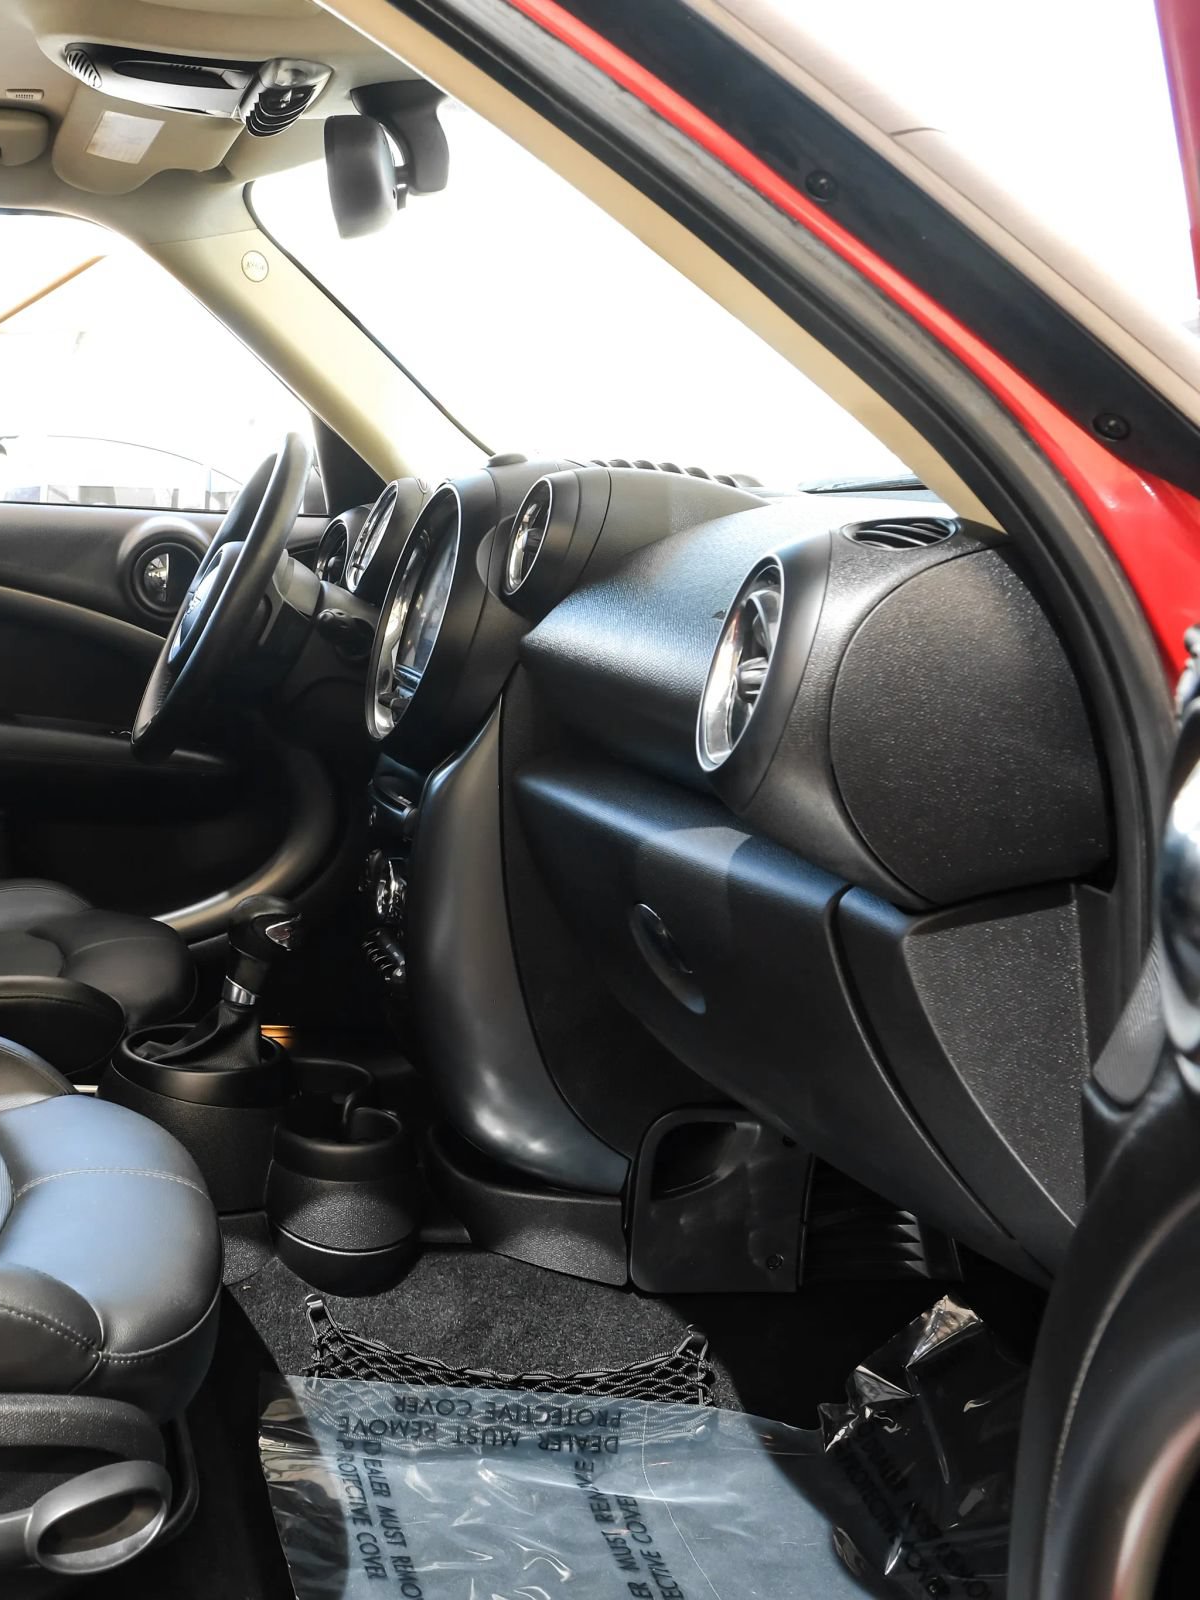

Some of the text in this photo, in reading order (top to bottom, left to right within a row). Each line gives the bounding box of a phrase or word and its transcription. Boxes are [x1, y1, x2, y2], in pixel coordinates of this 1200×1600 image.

[339, 1415, 619, 1455] DEALER MUST REMOVE
[394, 1395, 622, 1429] PROTECTIVE COVER
[335, 1438, 388, 1580] PROTECTIVE COVER
[362, 1440, 425, 1600] DEALER MUST REMO
[615, 1494, 653, 1544] COVE
[601, 1530, 640, 1572] MUST
